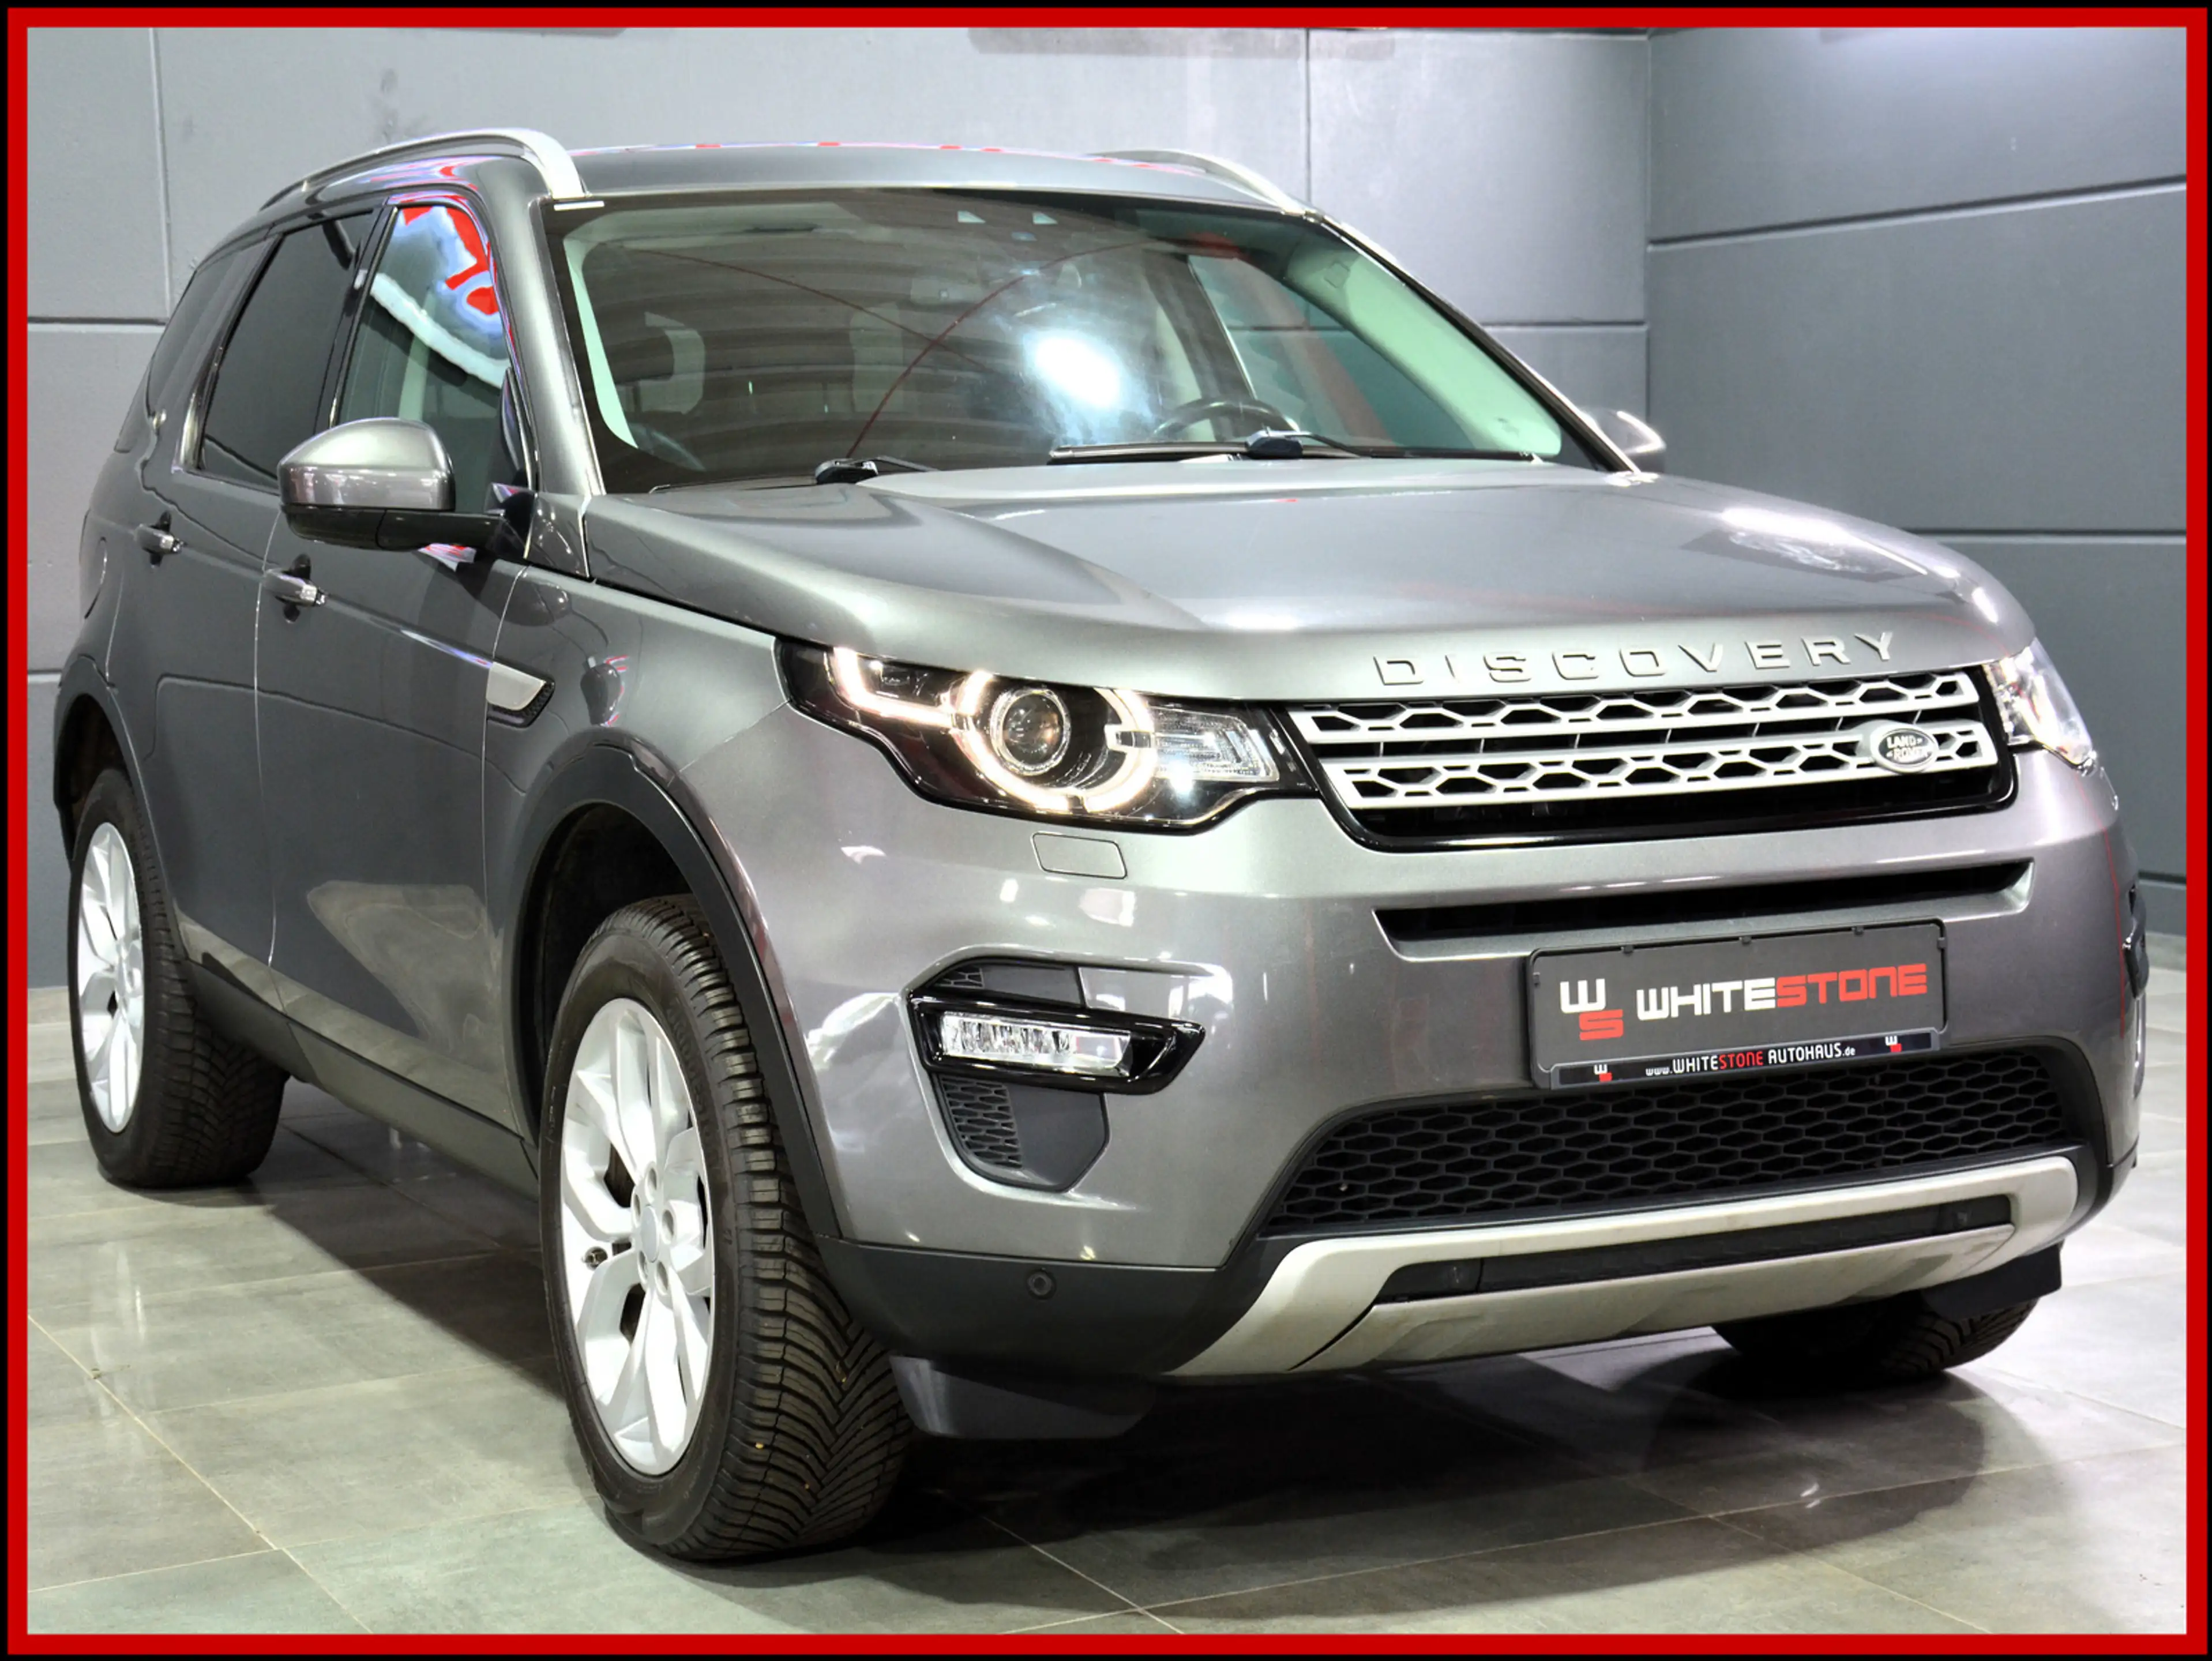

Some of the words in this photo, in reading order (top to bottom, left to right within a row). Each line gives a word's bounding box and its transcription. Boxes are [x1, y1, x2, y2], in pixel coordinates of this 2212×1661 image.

[1373, 632, 1893, 686] DISCOVERY
[1887, 734, 1917, 749] LAND
[1636, 963, 1928, 1021] WHITESTONE
[1767, 1042, 1856, 1065] AUTOHAUS.de
